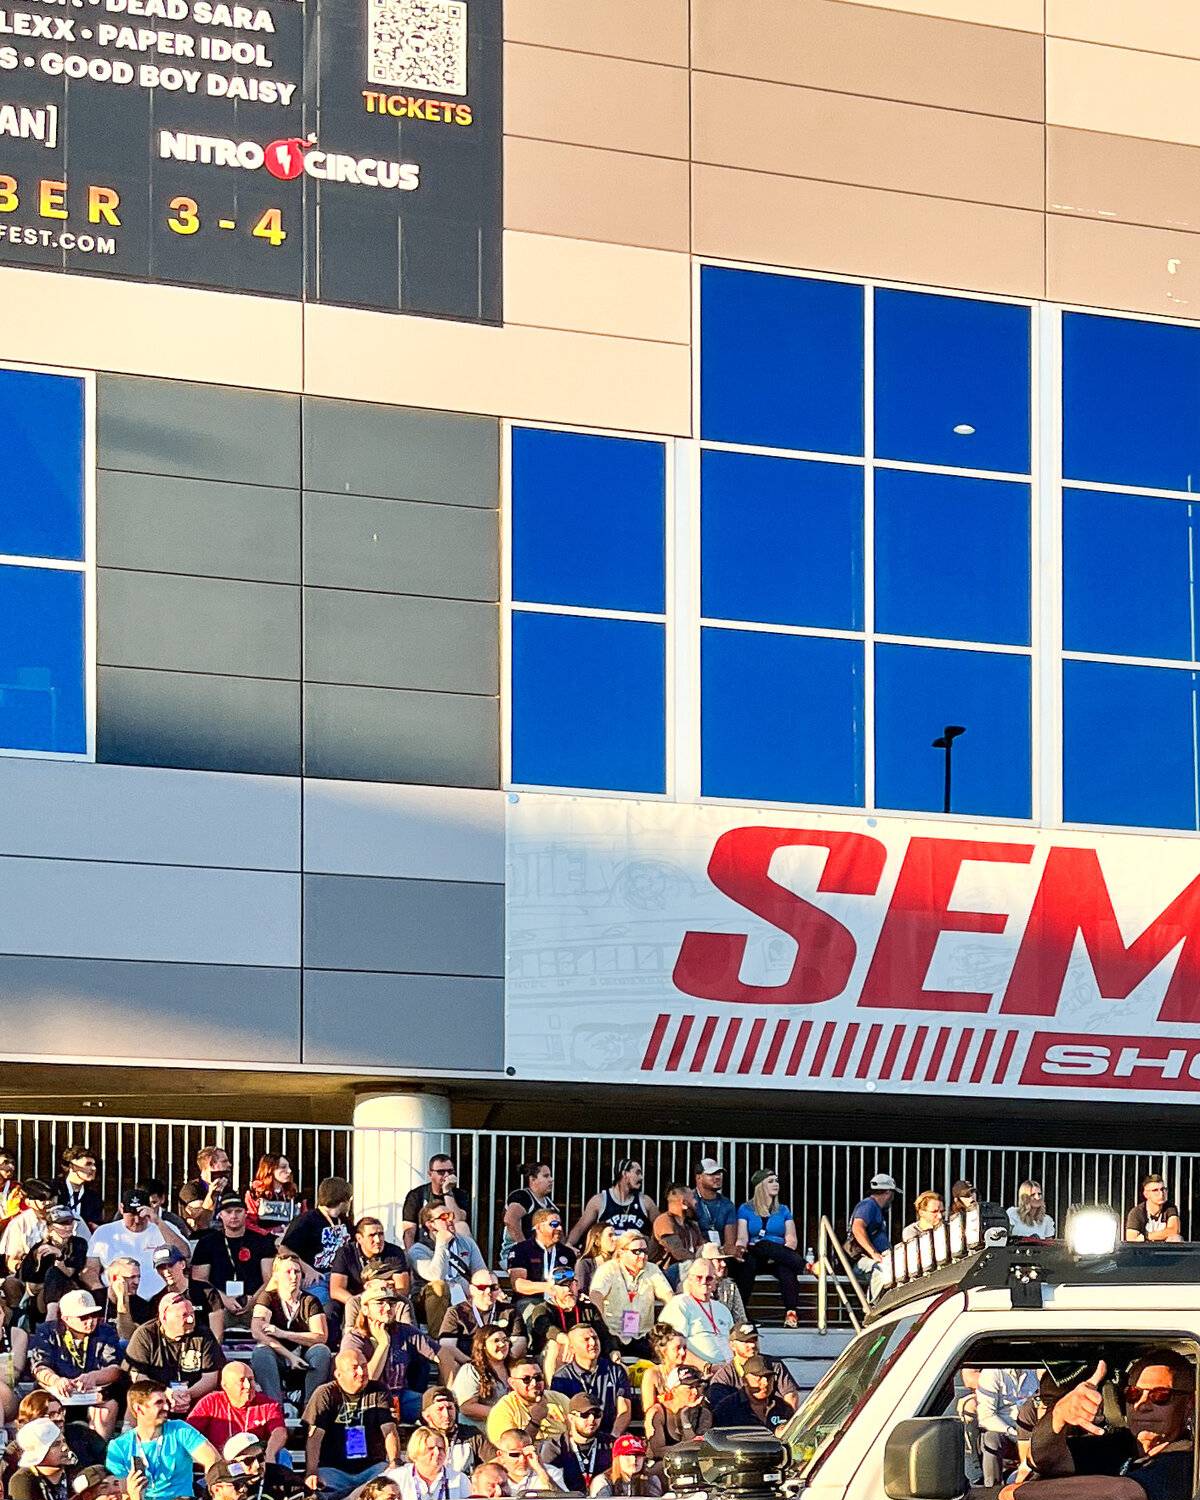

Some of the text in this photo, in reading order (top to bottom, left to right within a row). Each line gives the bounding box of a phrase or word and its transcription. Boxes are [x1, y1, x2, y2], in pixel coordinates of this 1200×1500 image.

[0, 10, 273, 68] LEXX PAPER IDOL
[193, 2, 276, 33] SARA
[40, 52, 134, 84] GOOD
[139, 64, 201, 93] BOY
[207, 73, 297, 106] DAISY
[361, 90, 473, 126] TICKETS
[159, 130, 420, 191] NITRO CIRCUS
[168, 196, 200, 235] 3
[252, 208, 286, 246] 4
